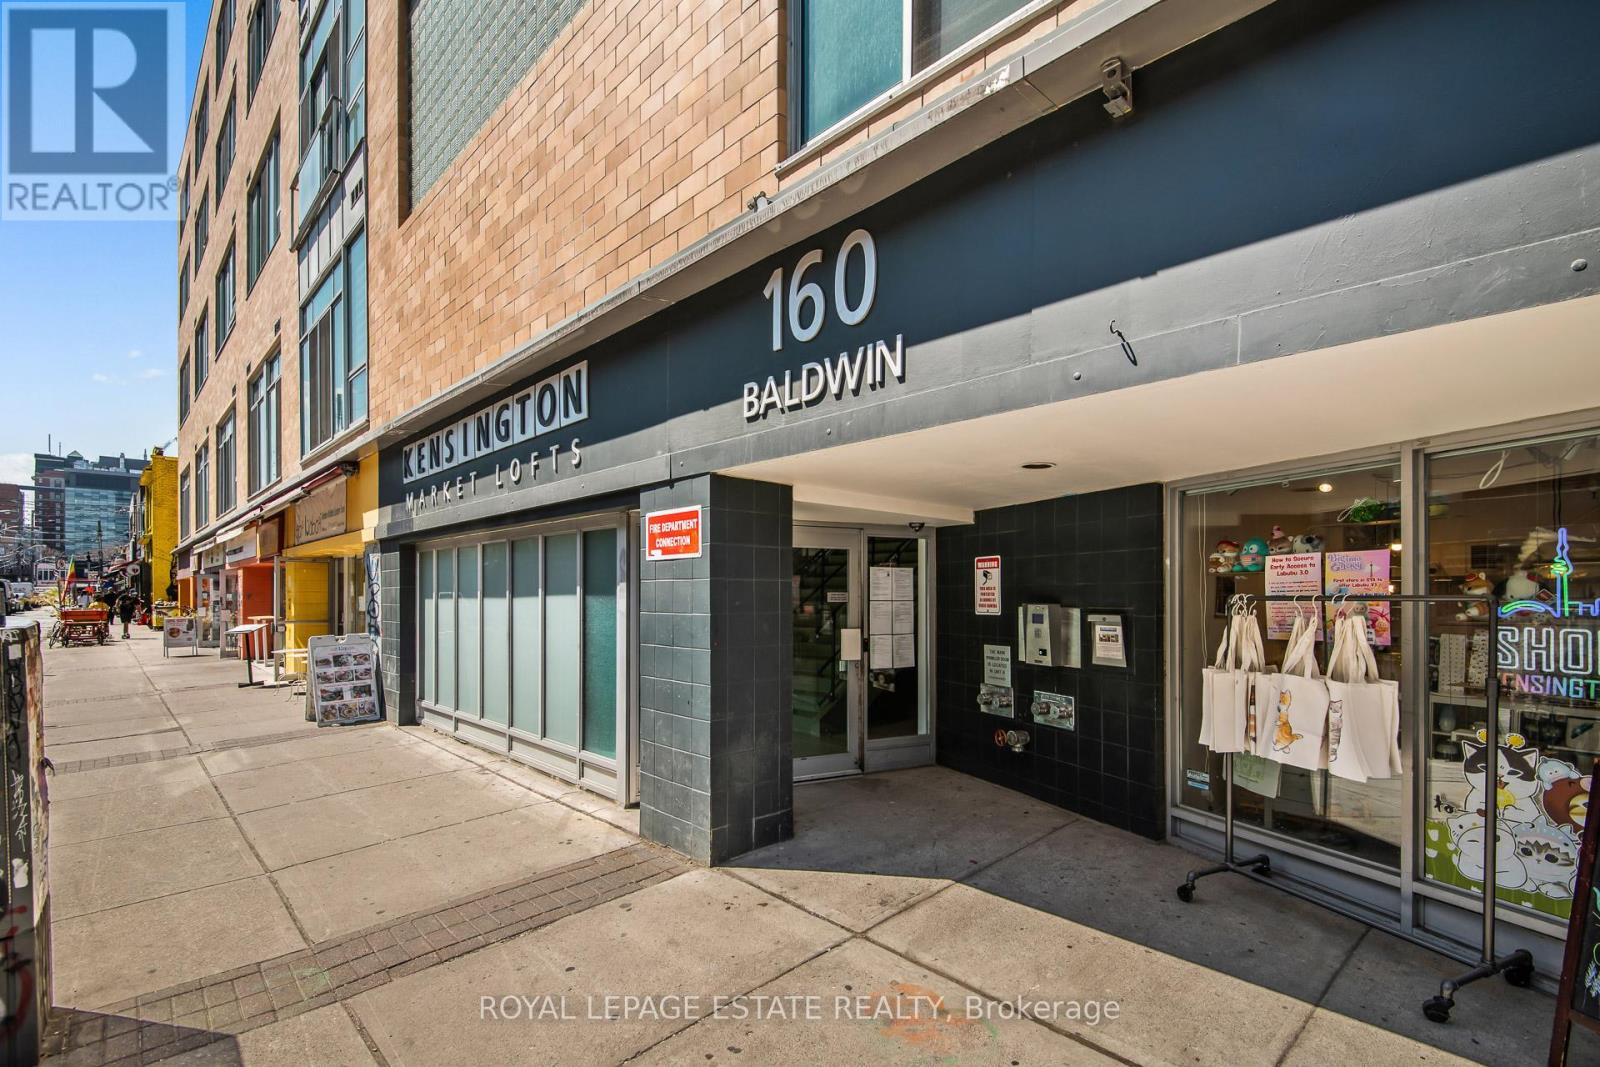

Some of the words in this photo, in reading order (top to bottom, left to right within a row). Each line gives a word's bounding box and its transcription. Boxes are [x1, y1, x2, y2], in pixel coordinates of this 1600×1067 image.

[762, 228, 877, 351] 160
[743, 333, 904, 419] BALDWIN
[403, 369, 582, 479] KENSINGTON
[405, 471, 477, 514] MARKET
[495, 437, 581, 487] LOFTS
[650, 523, 661, 534] FIRE
[661, 518, 698, 532] DEPARTMENT
[656, 535, 691, 548] CONNECTION
[1497, 626, 1600, 676] SHO
